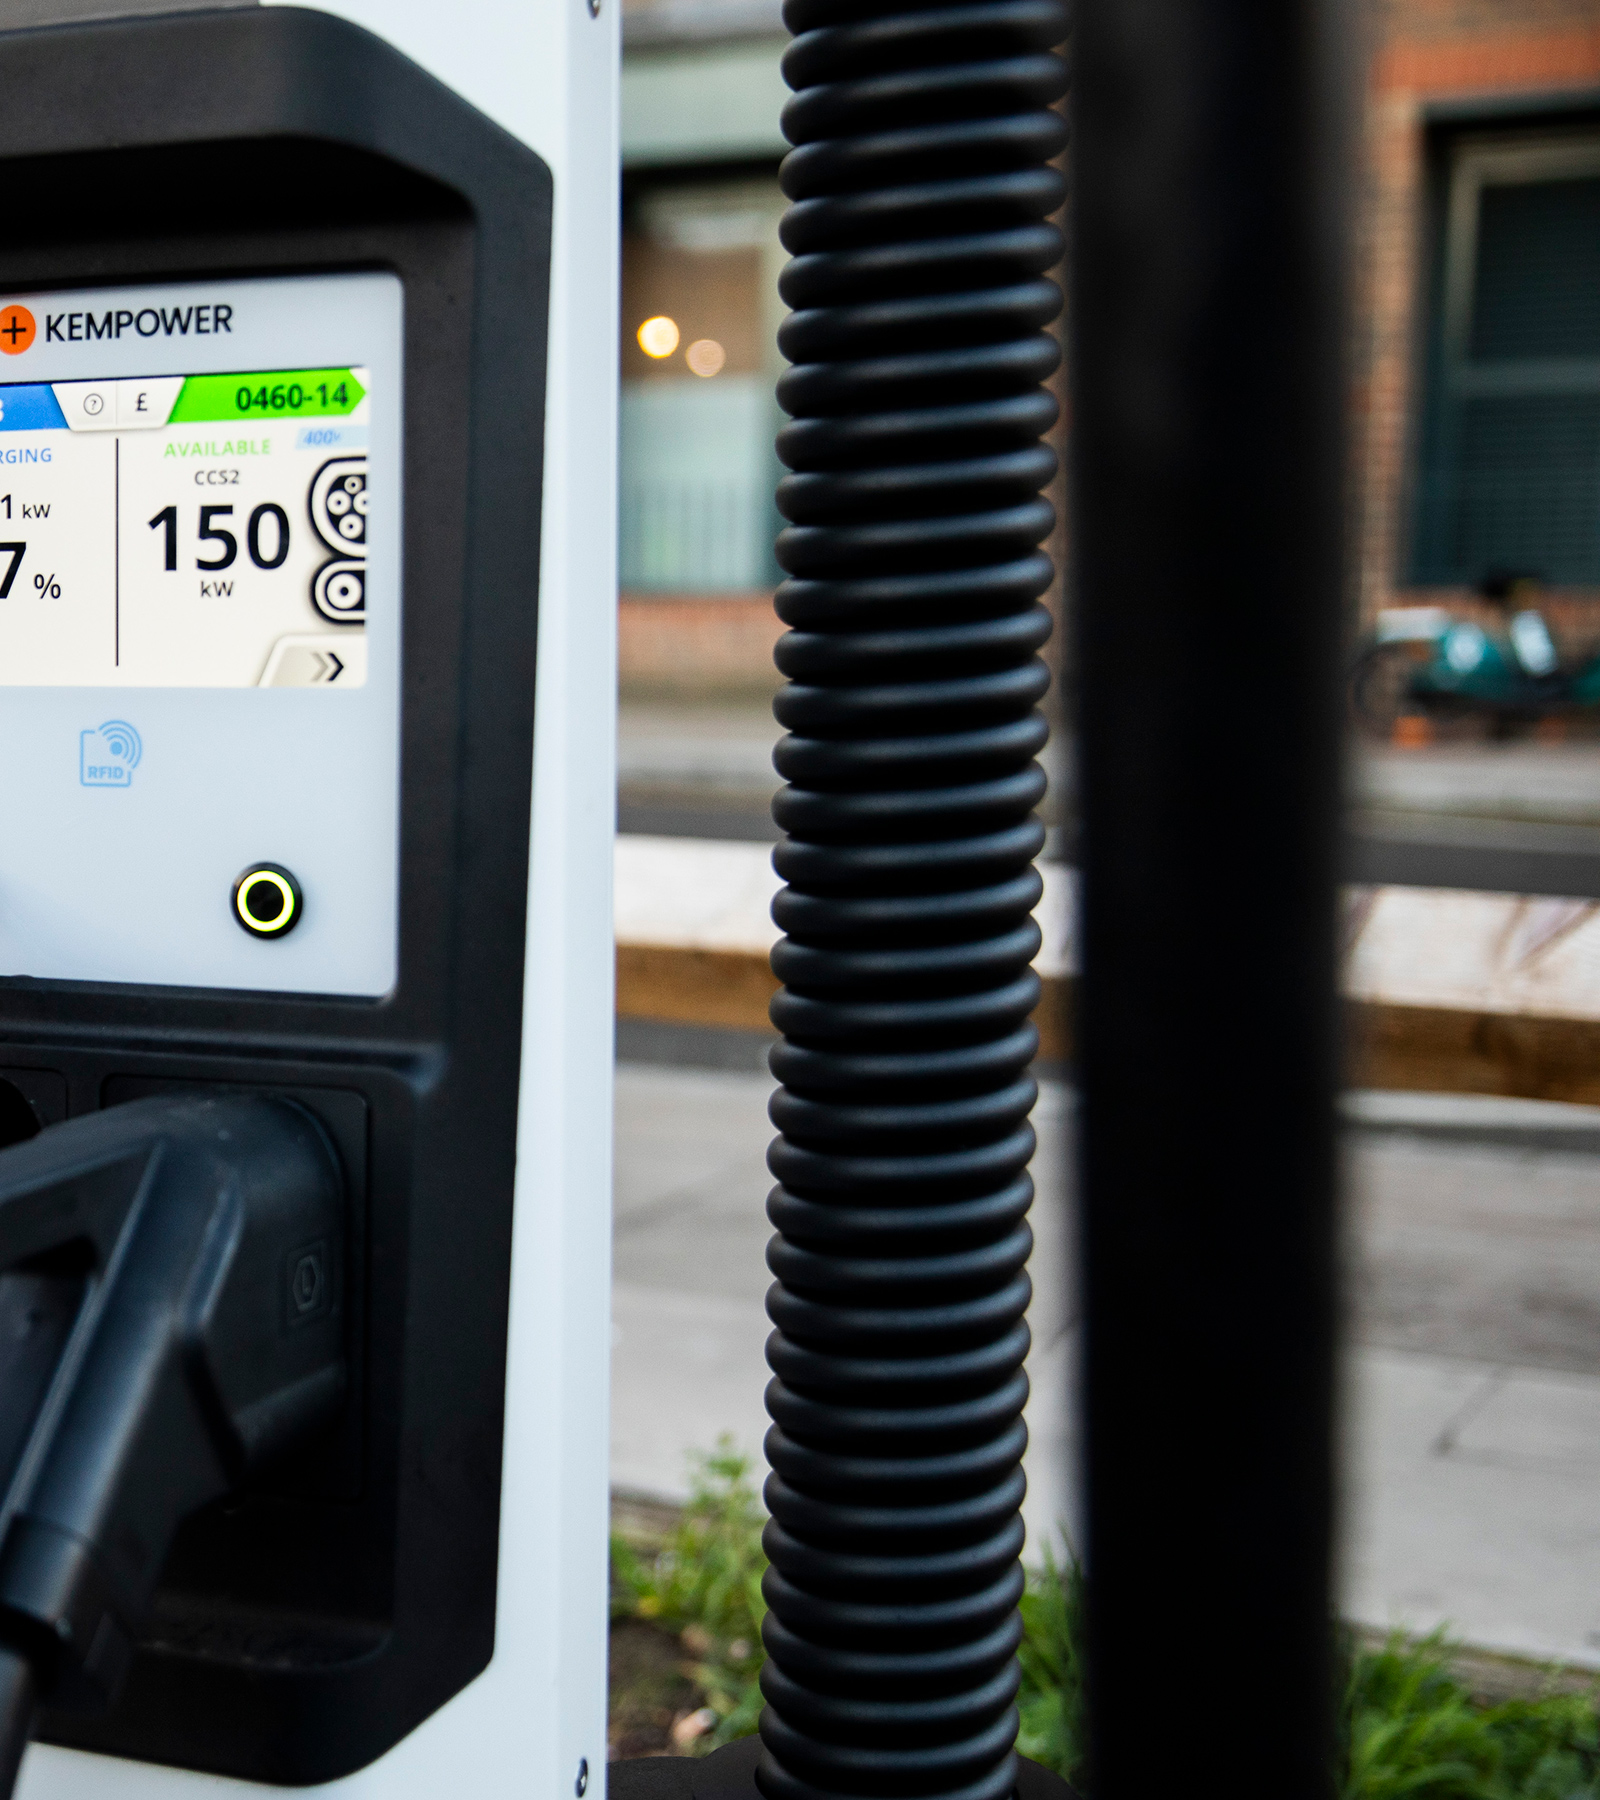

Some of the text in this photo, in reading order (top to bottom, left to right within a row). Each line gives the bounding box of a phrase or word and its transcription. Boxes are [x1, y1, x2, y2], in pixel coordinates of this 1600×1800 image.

[45, 304, 233, 341] KEMPOWER
[135, 392, 148, 412] £
[236, 382, 350, 412] 0460-14
[164, 439, 271, 459] AVAILABLE
[194, 470, 240, 486] CCS2
[22, 503, 51, 519] kW
[148, 503, 290, 572] 150
[33, 573, 62, 600] %
[200, 580, 234, 599] kW
[87, 766, 124, 779] RFID
